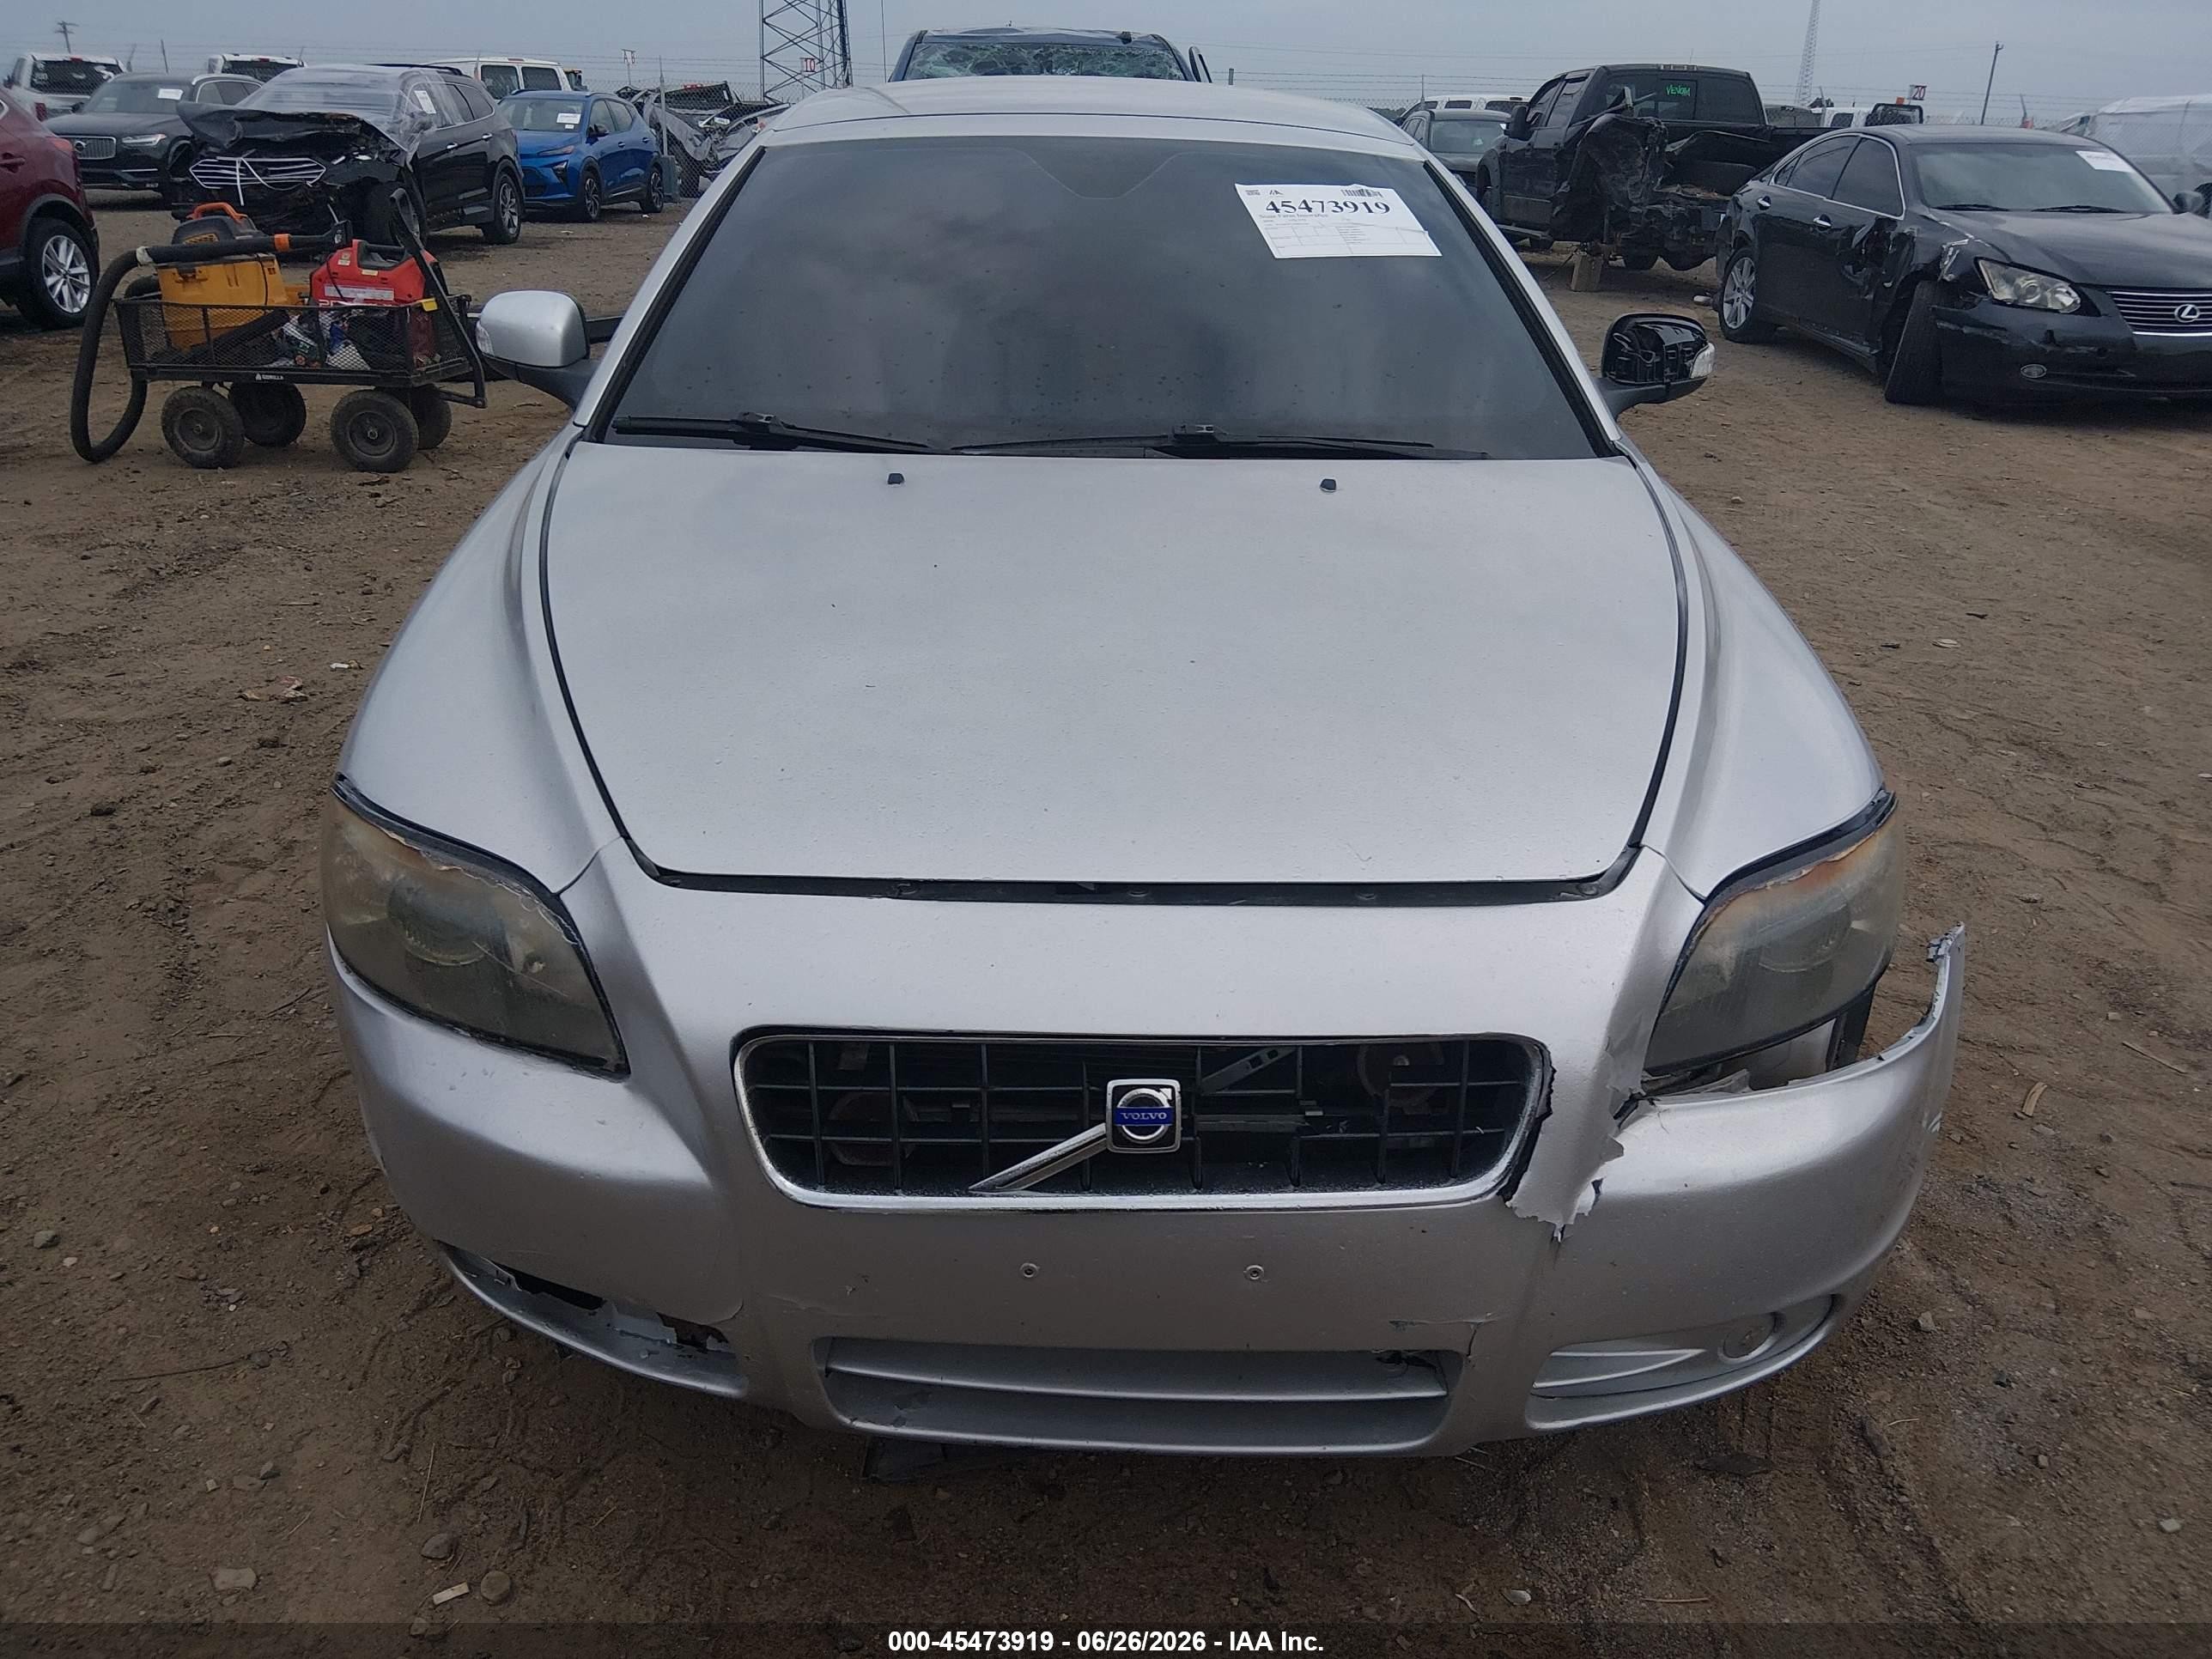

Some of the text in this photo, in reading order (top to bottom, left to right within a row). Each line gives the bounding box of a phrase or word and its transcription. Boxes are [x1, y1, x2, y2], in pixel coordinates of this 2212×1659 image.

[1911, 85, 1927, 100] 20
[1266, 198, 1390, 215] 45473919
[1119, 1111, 1168, 1121] VOLVO
